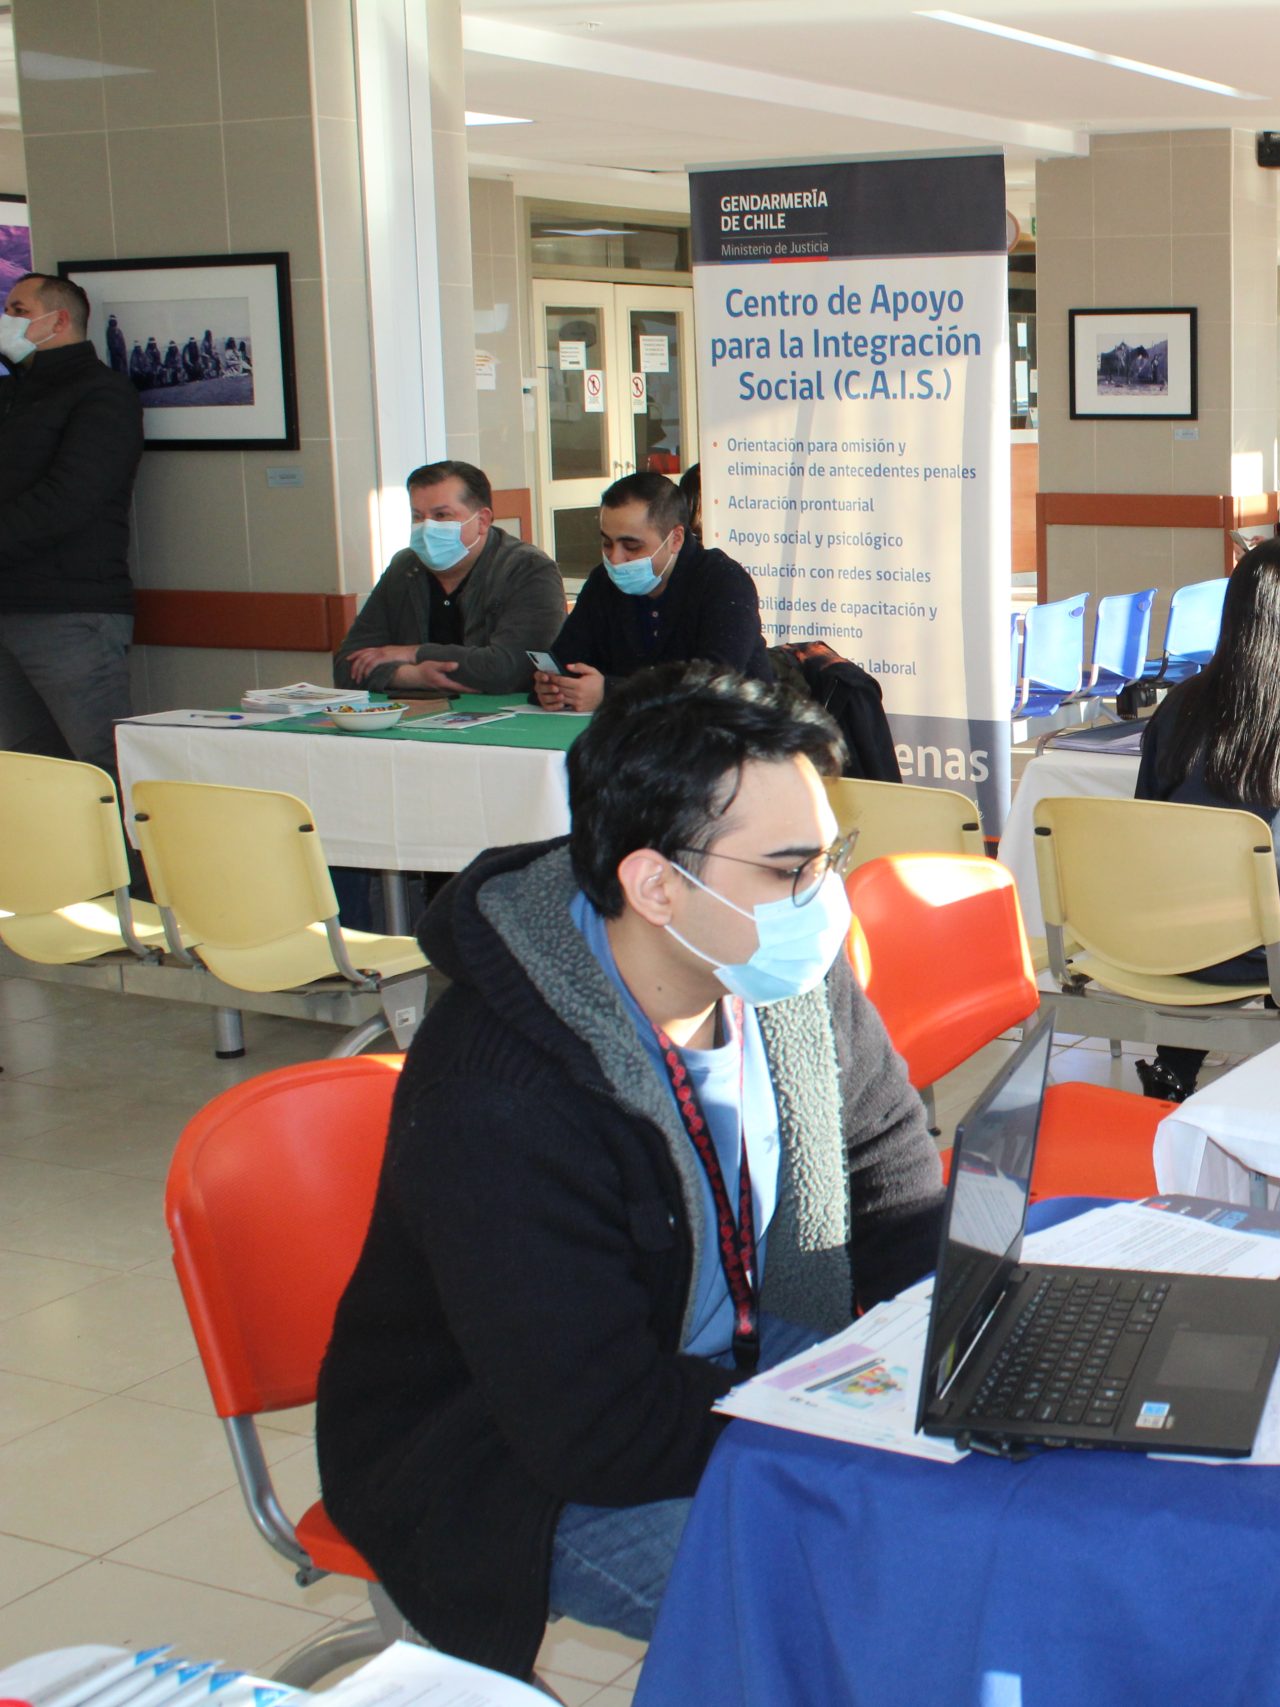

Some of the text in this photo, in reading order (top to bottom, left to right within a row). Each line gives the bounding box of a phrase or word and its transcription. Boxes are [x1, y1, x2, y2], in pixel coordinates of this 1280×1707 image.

[720, 188, 828, 212] GENDARMERÍA
[720, 213, 786, 232] DE CHILE
[721, 240, 829, 257] Ministerio de Justicia
[725, 284, 964, 321] Centro de Apoyo
[711, 325, 982, 367] para la Integración
[738, 368, 952, 402] Social (C.A.I.S.)
[727, 437, 906, 456] Orientación para omisión y
[727, 462, 977, 482] eliminación de antecedentes penales
[728, 495, 875, 514] Aclaración prontuarial
[728, 528, 904, 550] Apoyo social y psicológico
[810, 567, 834, 580] con
[838, 566, 872, 581] redes
[876, 568, 932, 583] sociales
[820, 598, 837, 613] de
[840, 601, 926, 618] capacitación
[928, 606, 938, 621] y
[760, 622, 863, 639] emprendimiento
[868, 660, 916, 676] laboral
